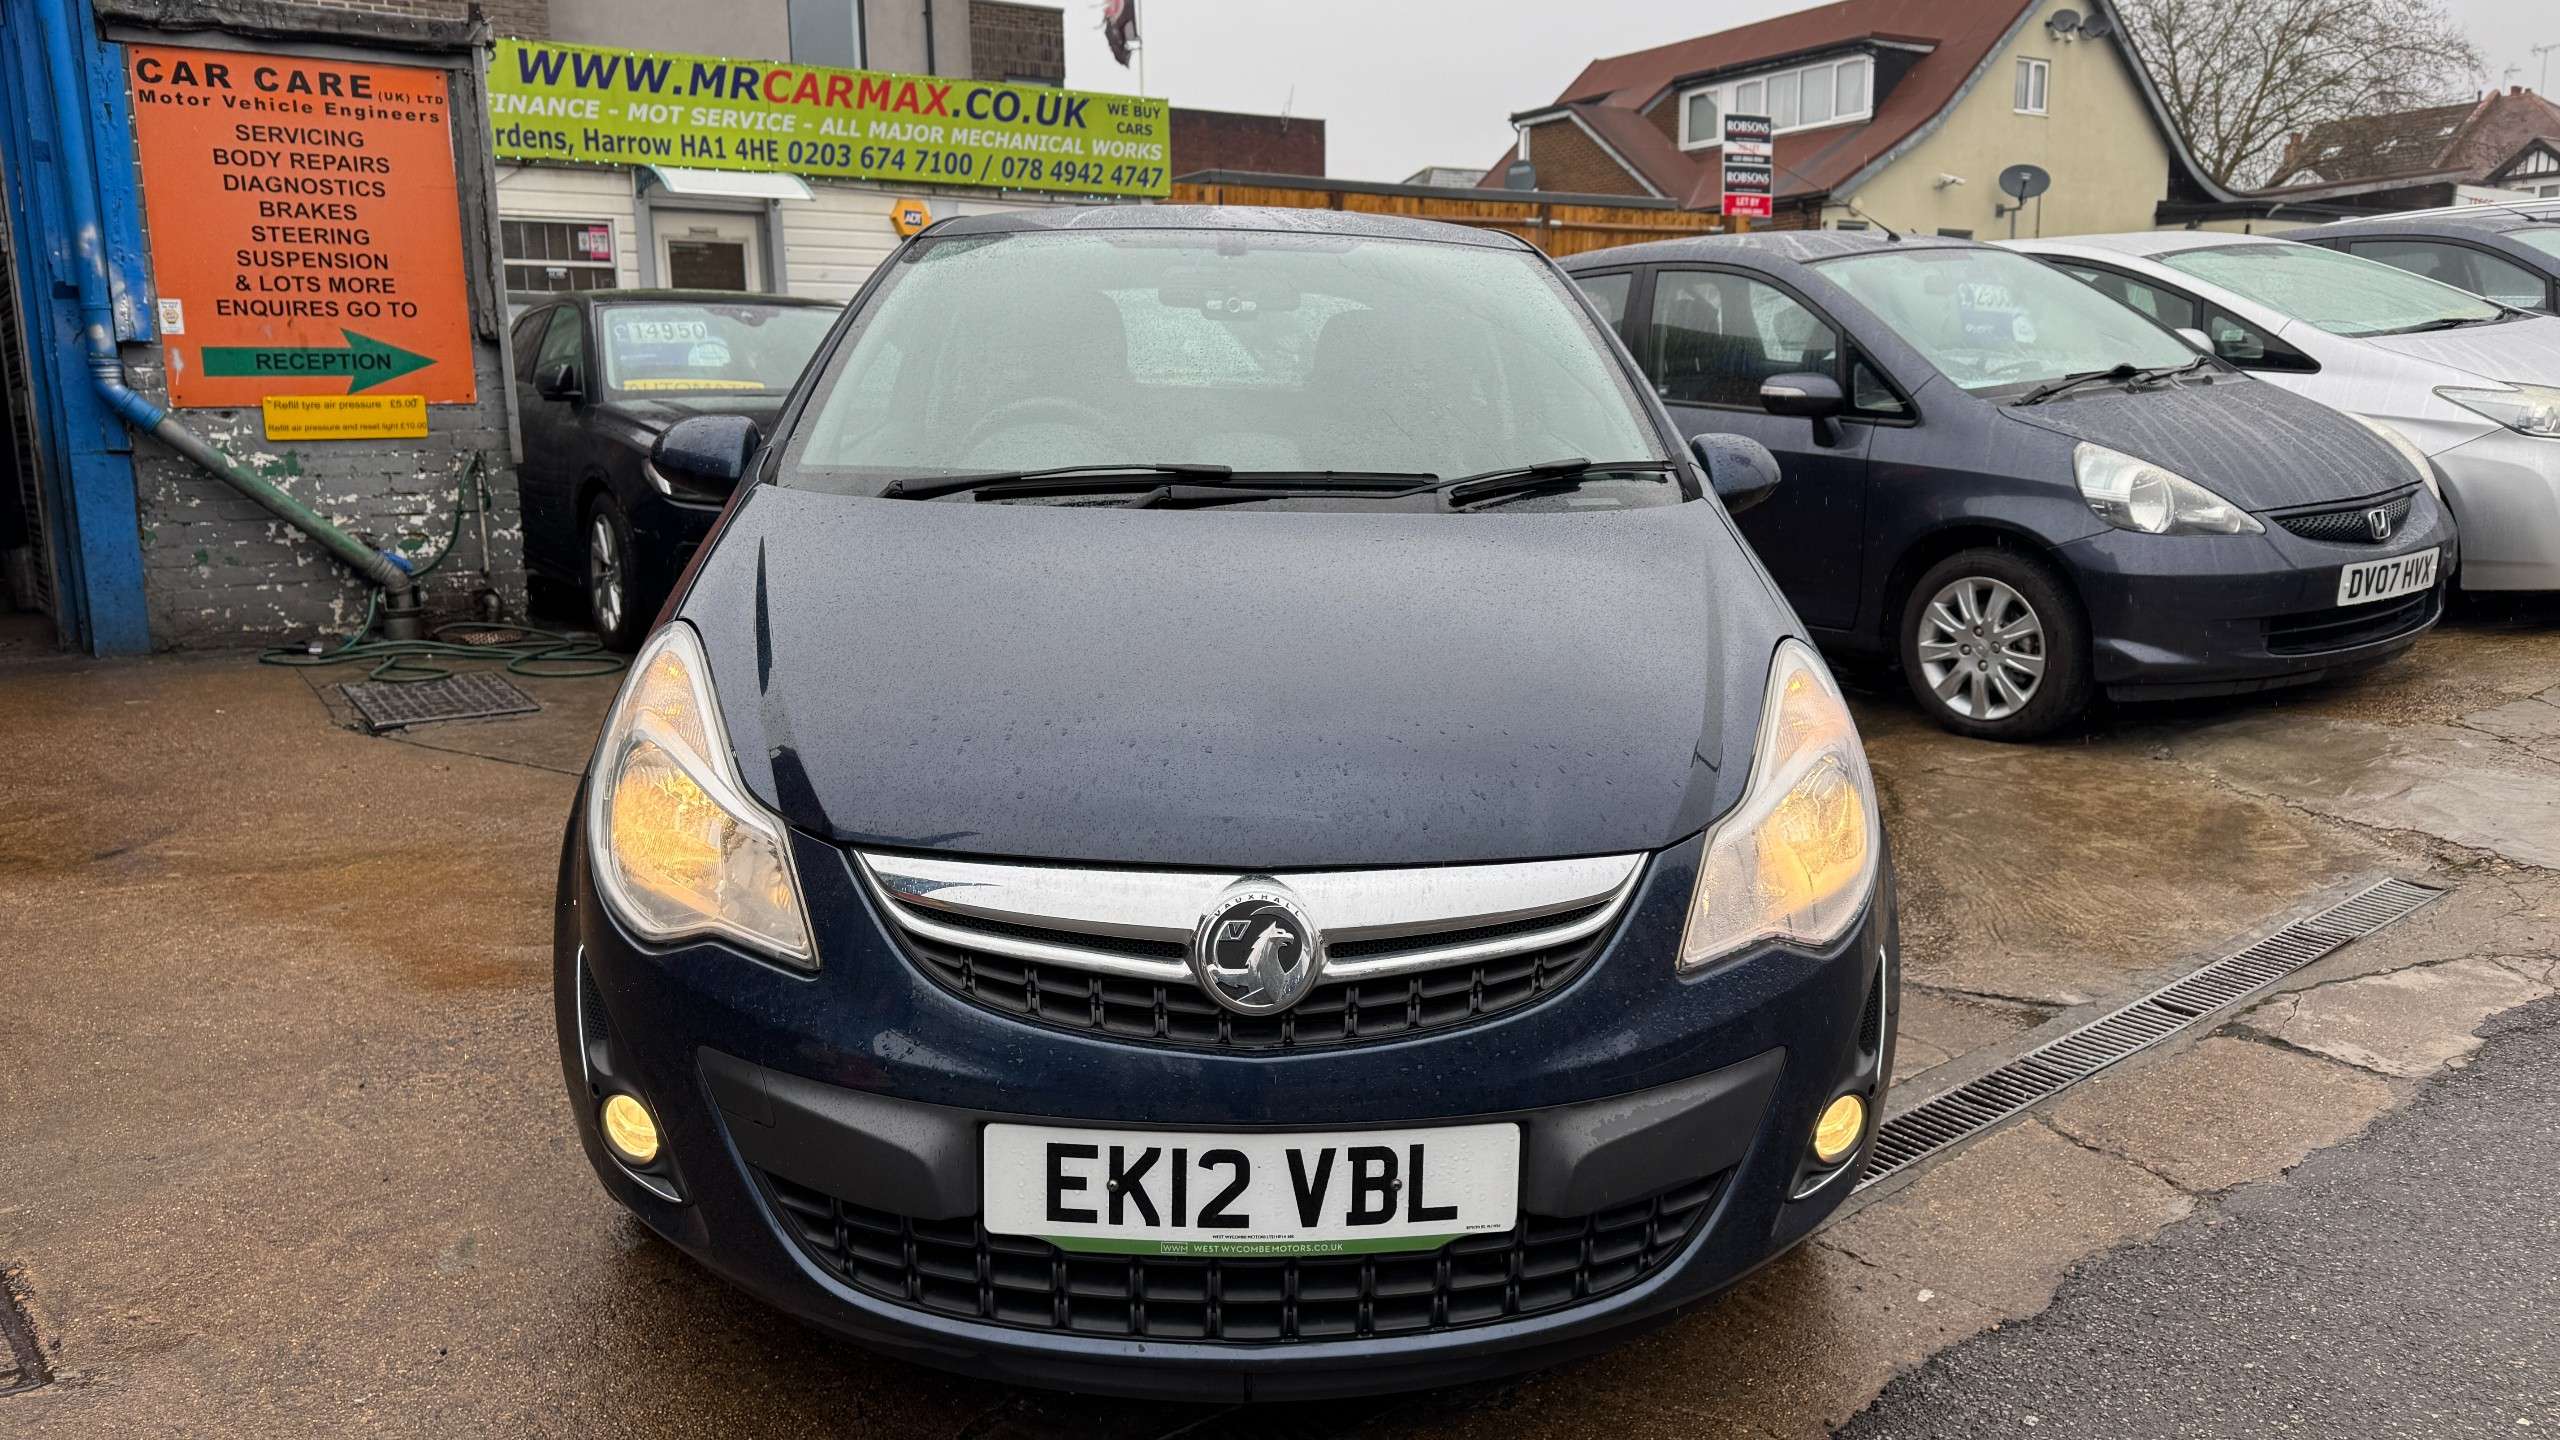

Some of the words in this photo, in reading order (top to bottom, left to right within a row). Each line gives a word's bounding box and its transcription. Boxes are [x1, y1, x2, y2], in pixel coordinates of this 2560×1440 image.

[136, 58, 231, 88] CAR
[254, 67, 373, 98] CARE
[378, 91, 410, 104] (UK)
[417, 93, 444, 106] LTD
[517, 48, 1089, 128] WWW.MRCARMAX.CO.UK
[138, 89, 211, 107] Motor
[222, 95, 313, 114] Vehicle
[325, 103, 440, 124] Engineers
[1107, 103, 1129, 116] WE
[1133, 104, 1161, 119] BUY
[235, 124, 365, 148] SERVICING
[627, 102, 684, 124] MOT
[691, 108, 795, 132] SERVICE
[819, 117, 861, 137] ALL
[868, 120, 944, 144] MAJOR
[952, 128, 1084, 155] MECHANICAL
[1092, 139, 1162, 160] WORKS
[1116, 121, 1153, 136] CARS
[1727, 120, 1770, 134] ROBSONS
[213, 148, 282, 169] BODY
[290, 152, 390, 174] REPAIRS
[495, 122, 574, 156] rdens,
[583, 128, 672, 155] Harrow
[680, 134, 727, 160] HA1
[735, 137, 778, 162] 4HE
[787, 140, 849, 168] 0203
[861, 145, 905, 171] 674
[915, 150, 972, 176] 7100
[1001, 157, 1042, 181] 078
[1050, 159, 1103, 185] 4942
[1110, 164, 1163, 188] 4747
[224, 174, 386, 198] DIAGNOSTICS
[1727, 171, 1770, 185] ROBSONS
[259, 201, 358, 221] BRAKES
[1735, 196, 1748, 206] LET
[252, 226, 370, 245] STEERING
[237, 250, 389, 270] SUSPENSION
[235, 274, 251, 292] &
[260, 275, 321, 293] LOTS
[329, 277, 396, 295] MORE
[216, 299, 339, 318] ENQUIRES
[347, 301, 380, 318] GO
[387, 302, 418, 319] TO
[256, 353, 392, 371] RECEPTION
[273, 400, 300, 410] Refill
[302, 400, 321, 411] tyre
[323, 400, 336, 409] air
[339, 401, 381, 411] pressure
[304, 423, 340, 433] pressure
[342, 423, 359, 431] and
[2347, 562, 2401, 599] DV07
[2401, 553, 2434, 589] HVX
[1214, 894, 1300, 917] VAUXHALL
[1046, 1142, 1251, 1229] EK12
[1285, 1143, 1458, 1228] VBL
